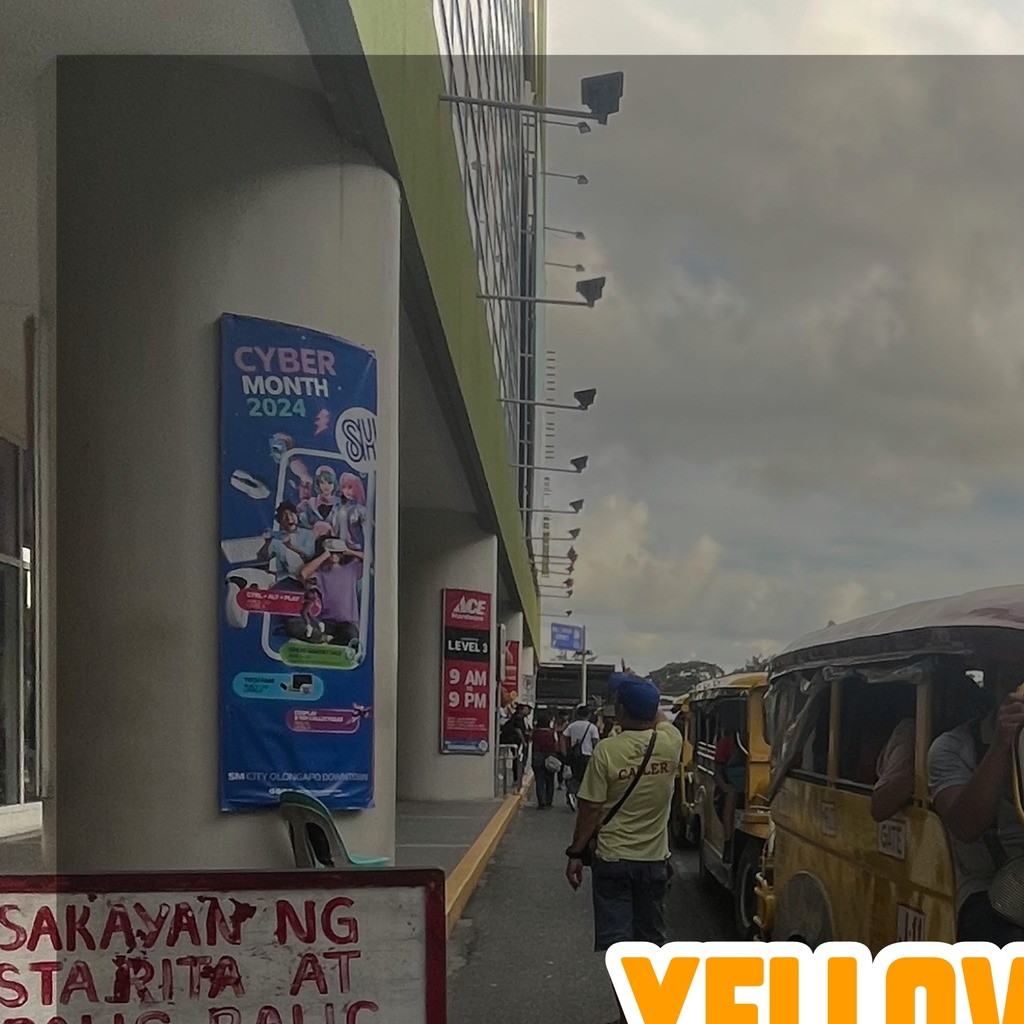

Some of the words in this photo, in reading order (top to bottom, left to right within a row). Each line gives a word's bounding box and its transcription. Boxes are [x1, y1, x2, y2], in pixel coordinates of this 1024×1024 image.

[233, 345, 337, 377] CYBER
[241, 374, 330, 398] MONTH
[246, 397, 308, 418] 2024
[453, 595, 487, 616] ACE
[447, 640, 481, 653] LEVEL
[482, 642, 489, 654] 3
[449, 668, 461, 685] 9
[464, 669, 487, 687] AM
[448, 691, 460, 708] 9
[464, 692, 487, 709] PM
[228, 772, 245, 781] SM
[246, 772, 268, 781] CITY
[269, 772, 321, 782] OLONGAPO
[618, 762, 669, 781] CALER
[275, 897, 360, 945] NG
[289, 950, 362, 996] AT
